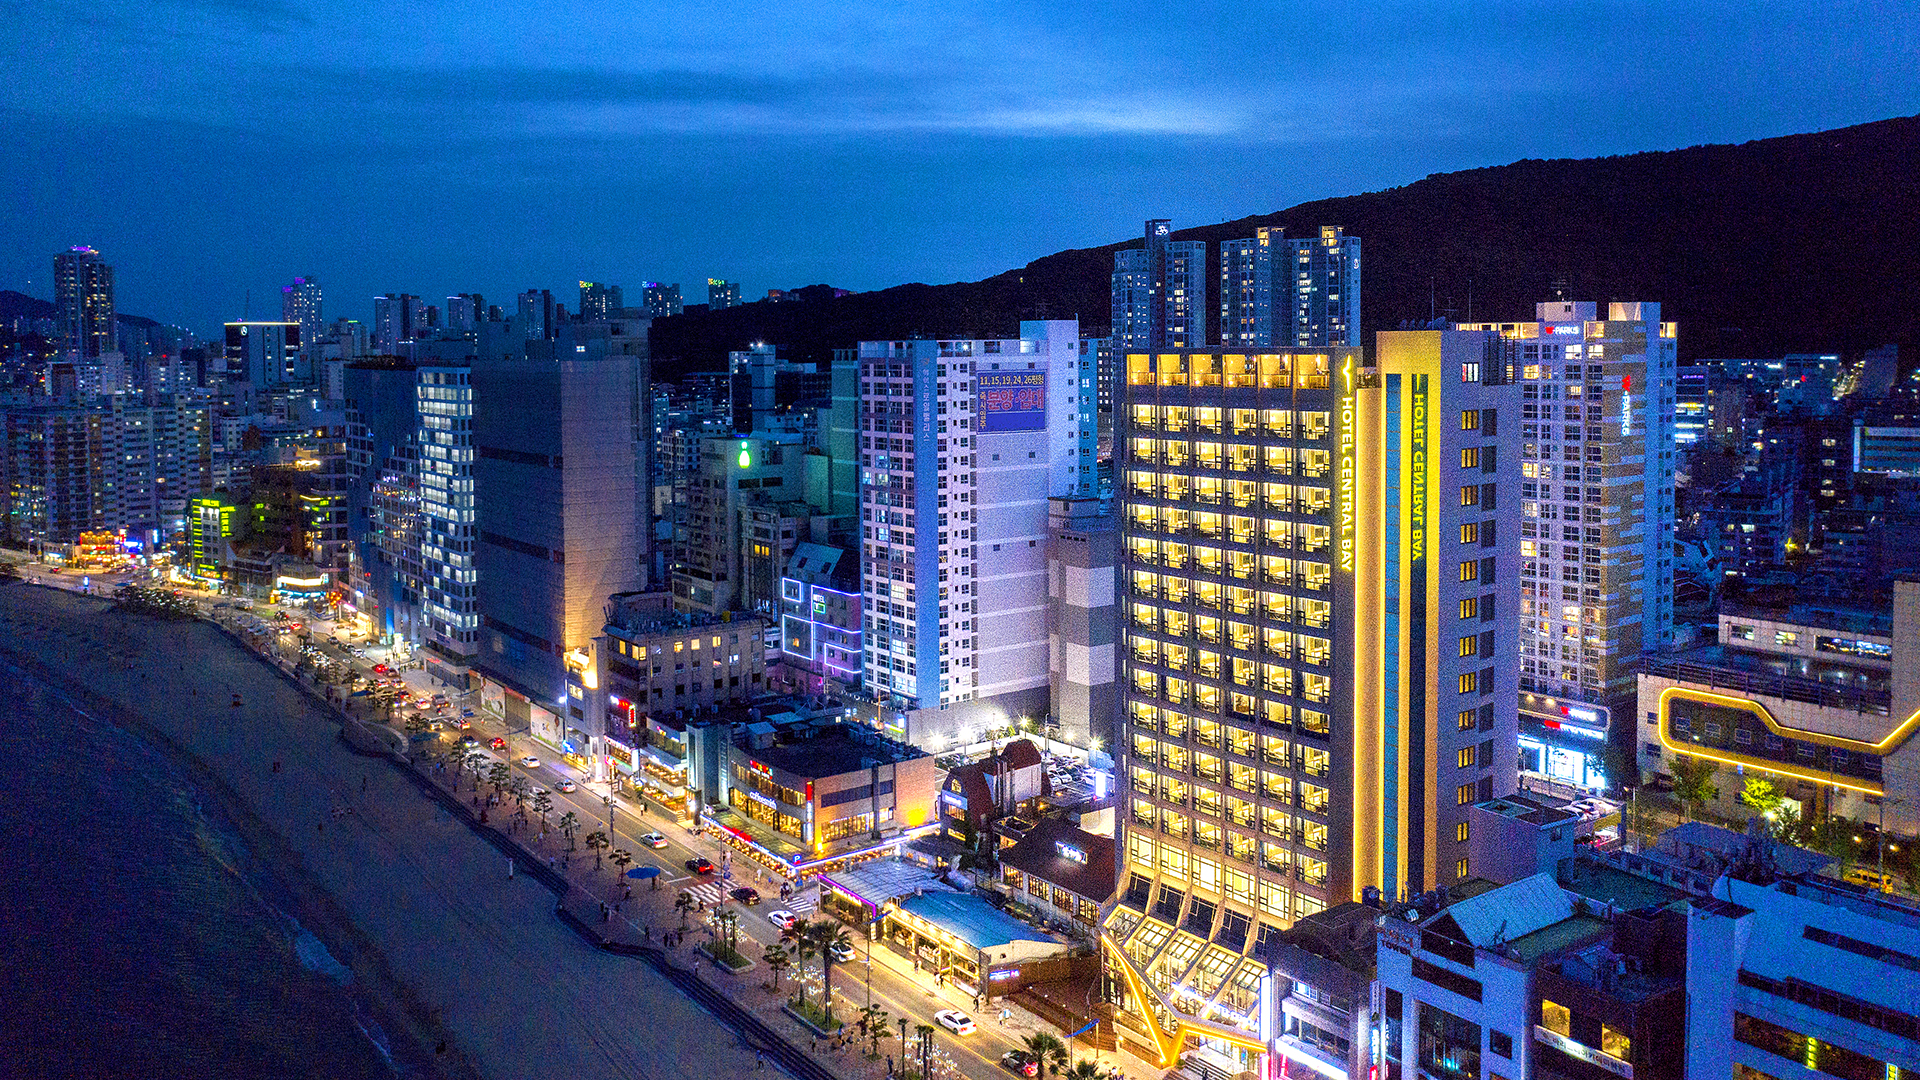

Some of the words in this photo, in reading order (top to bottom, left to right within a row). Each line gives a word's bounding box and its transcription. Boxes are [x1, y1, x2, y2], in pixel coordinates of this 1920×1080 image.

[1342, 397, 1353, 454] HOTEL
[1342, 457, 1353, 535] CENTRAL
[1341, 539, 1353, 572] BAY
